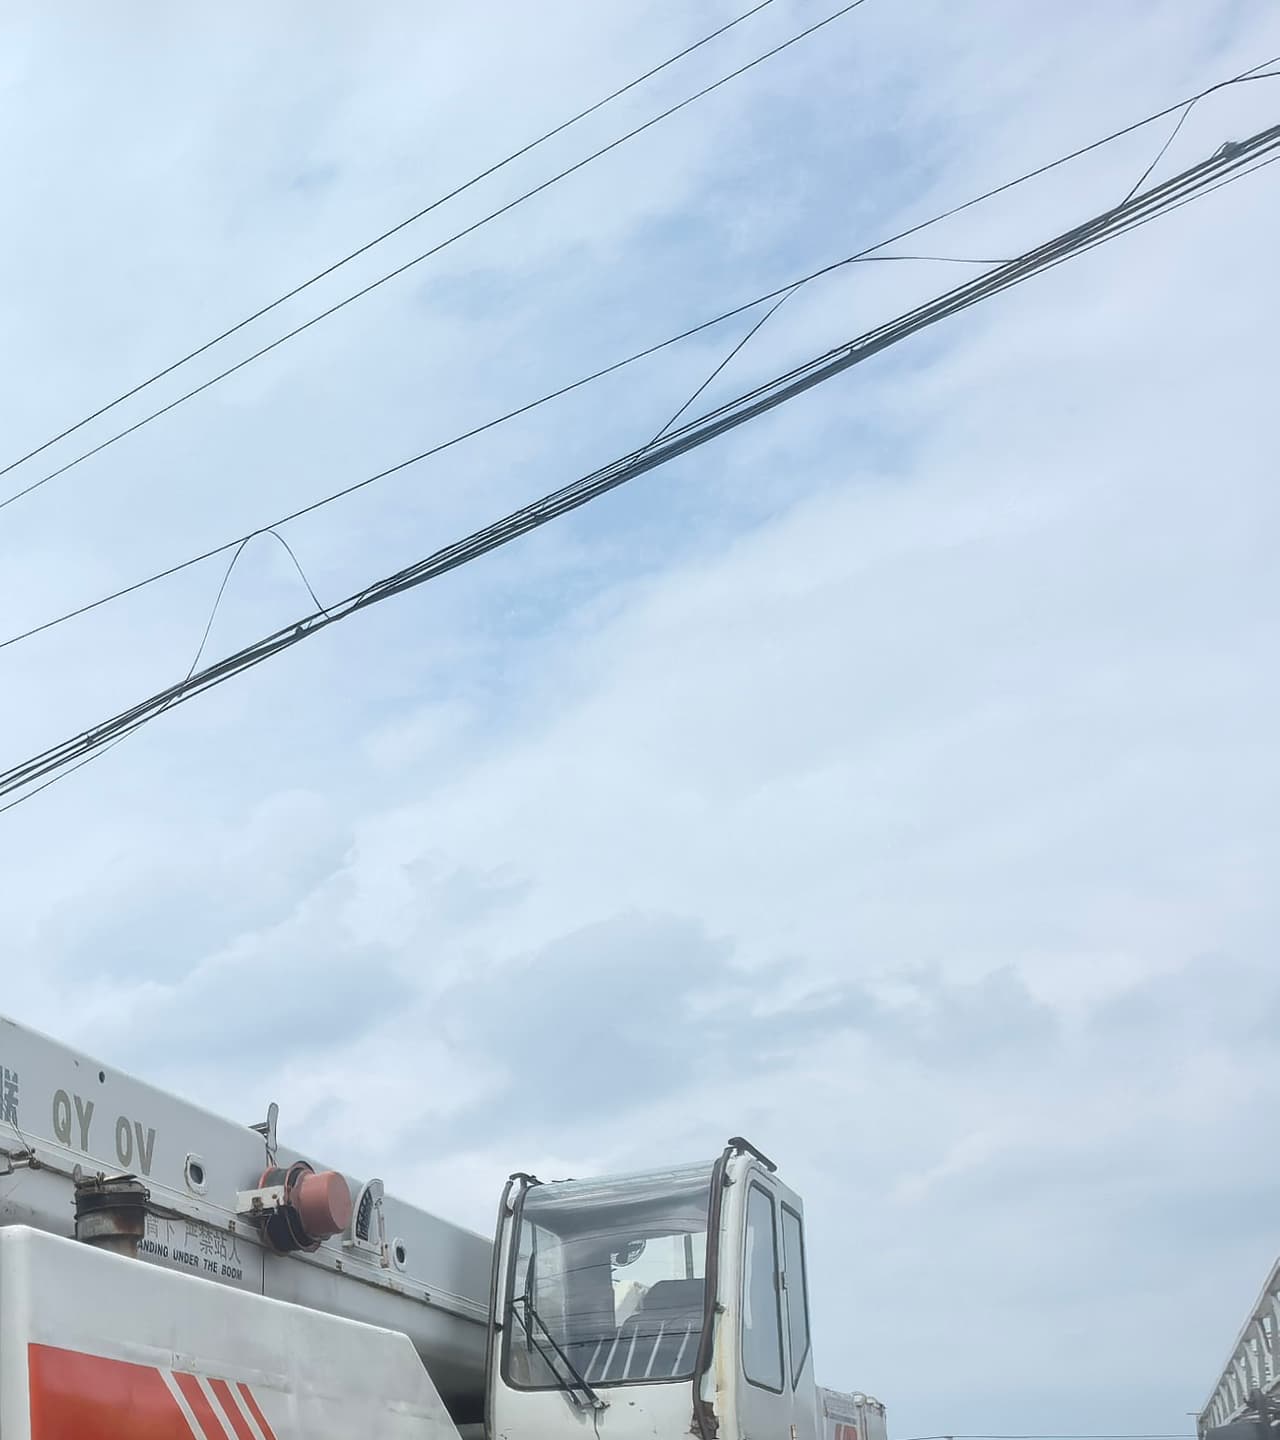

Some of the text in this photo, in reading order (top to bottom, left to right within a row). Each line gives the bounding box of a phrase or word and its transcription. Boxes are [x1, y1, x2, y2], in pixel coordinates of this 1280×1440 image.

[137, 1239, 243, 1281] ANDING UNDER THE BOOM
